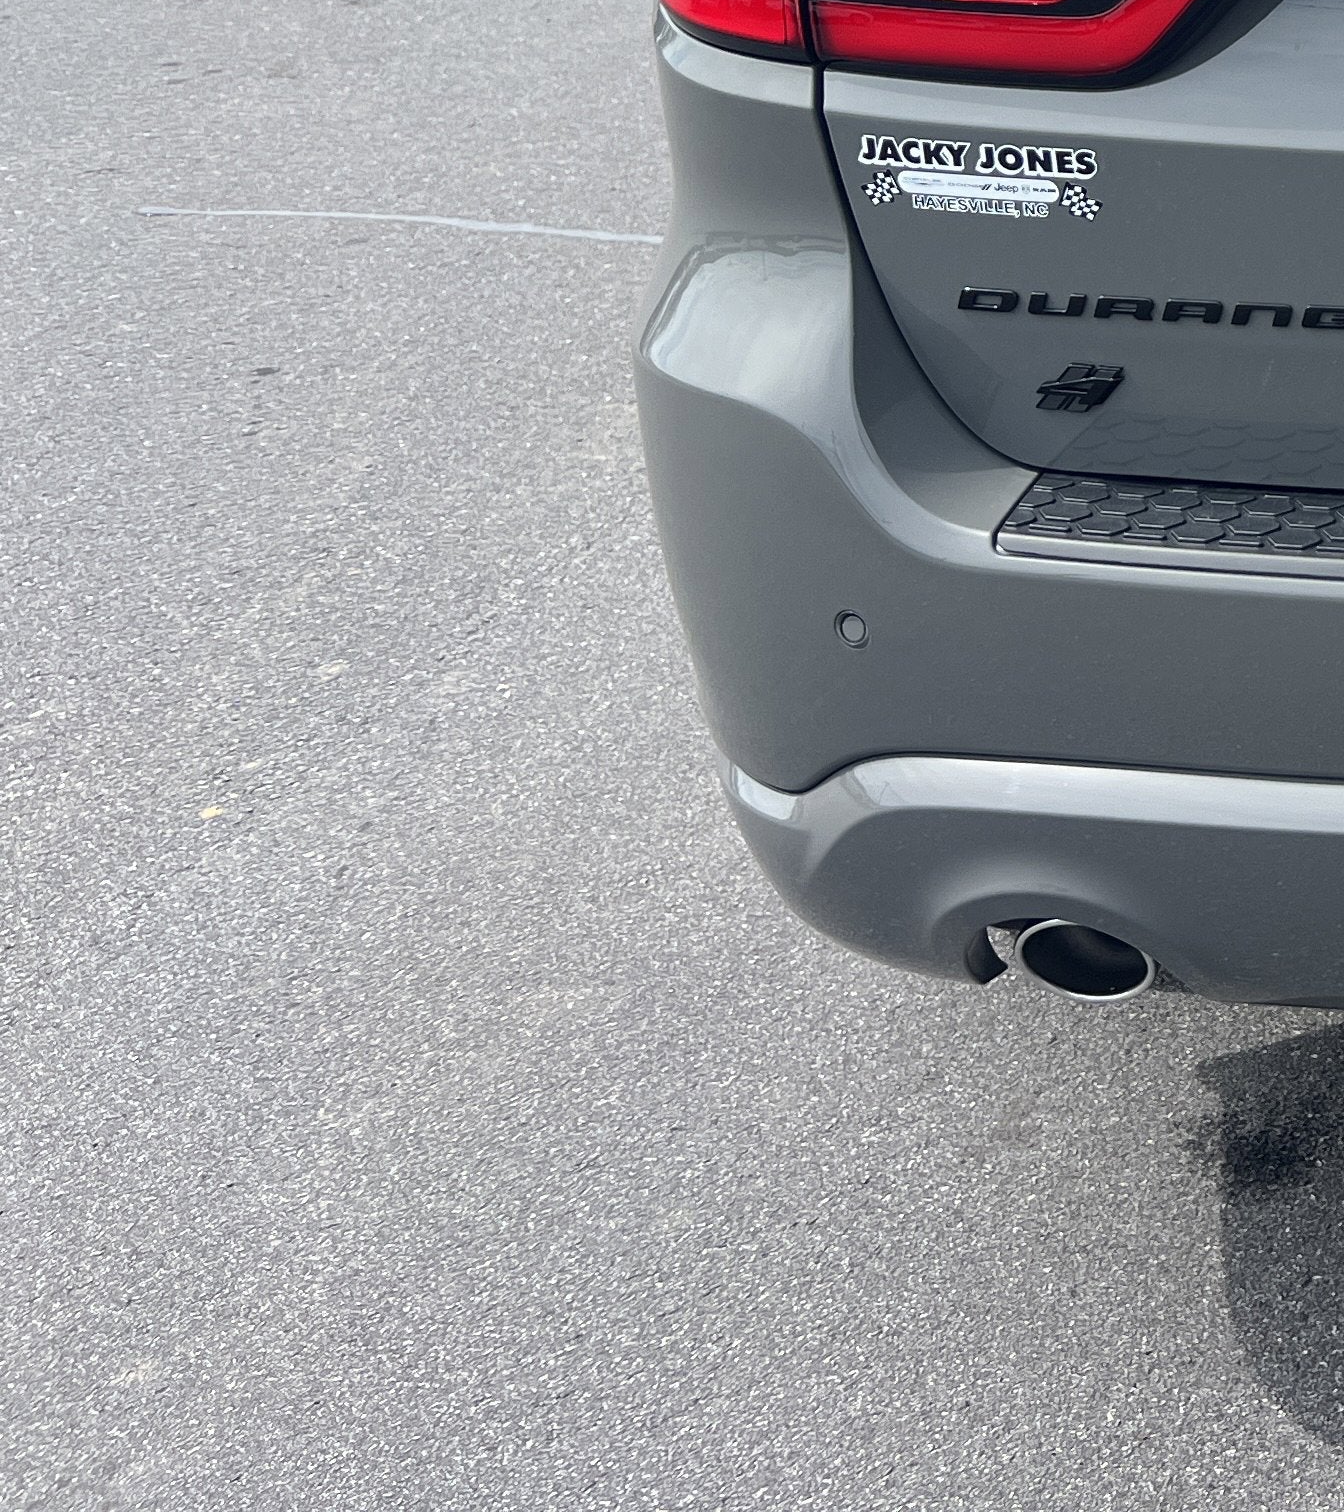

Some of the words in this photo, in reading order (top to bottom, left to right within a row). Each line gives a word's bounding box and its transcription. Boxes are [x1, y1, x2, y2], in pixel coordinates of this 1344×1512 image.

[859, 135, 970, 170] JACKY
[976, 144, 1098, 179] JONES
[994, 183, 1019, 194] Jeep
[912, 194, 1020, 218] HAYESVILLE,
[1023, 202, 1049, 218] NC
